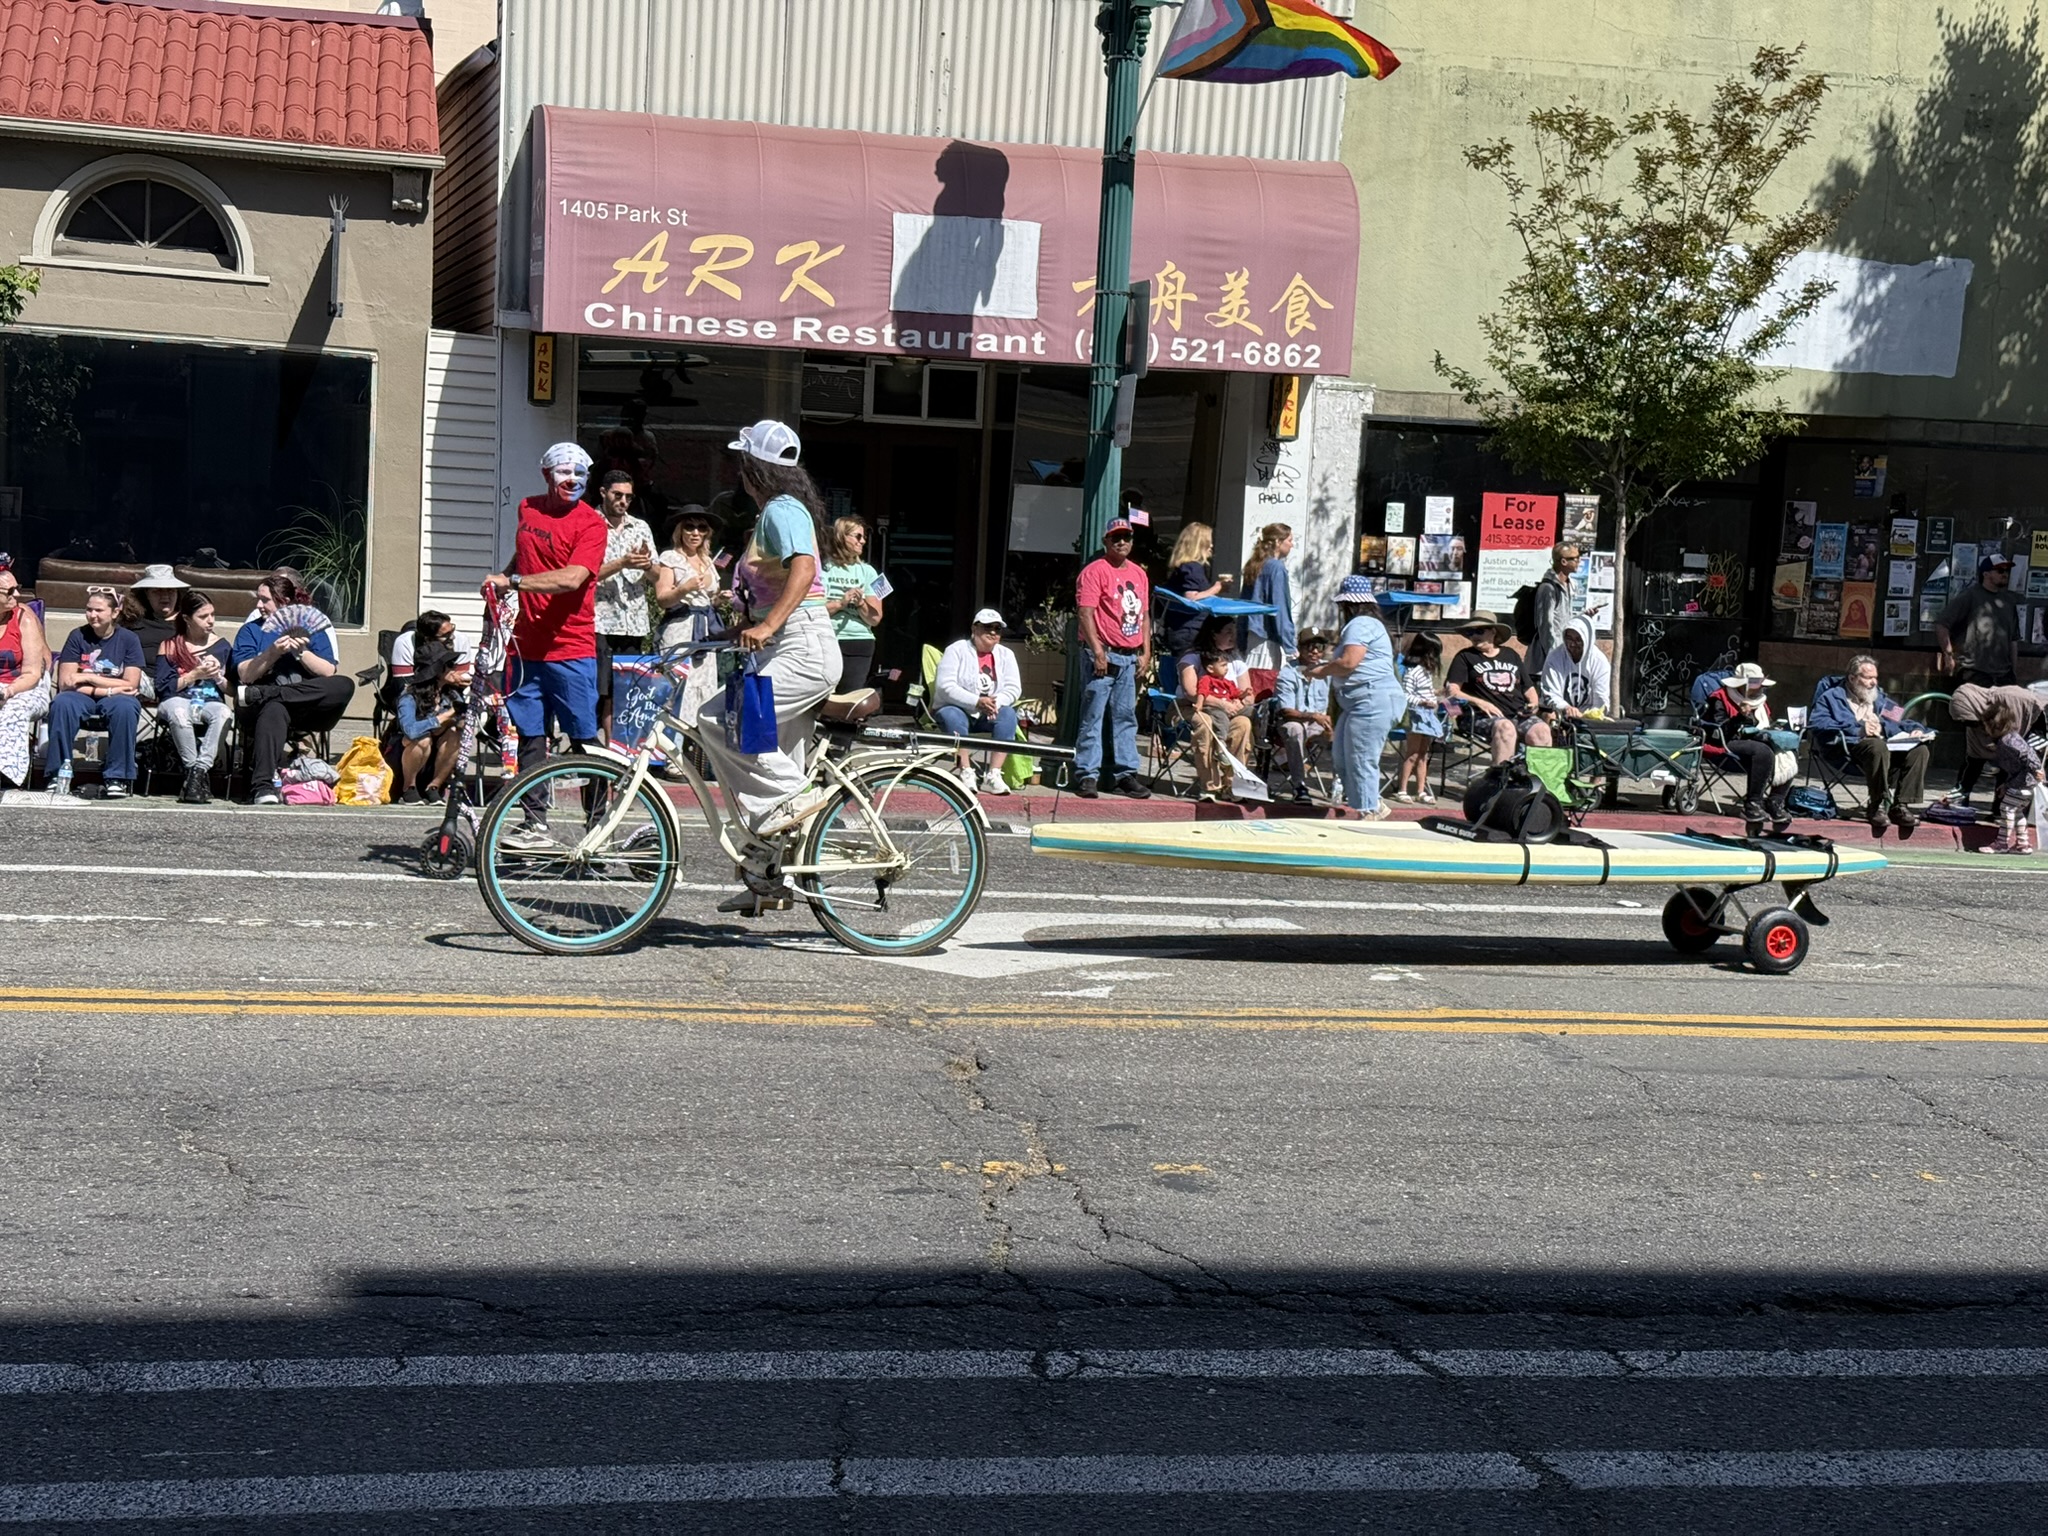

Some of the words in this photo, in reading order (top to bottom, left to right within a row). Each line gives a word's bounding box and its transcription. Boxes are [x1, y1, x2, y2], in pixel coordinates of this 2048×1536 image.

[559, 198, 608, 219] 1405
[614, 204, 661, 224] Park
[667, 208, 688, 226] St
[601, 230, 845, 307] ARK
[584, 302, 777, 339] Chinese
[792, 317, 1046, 355] Restaurant
[1170, 337, 1322, 368] 521-6862
[536, 342, 549, 393] ARK
[1258, 492, 1294, 504] PABLO
[1505, 497, 1537, 513] For
[1492, 514, 1545, 531] Lease
[1482, 558, 1507, 566] Justin
[1509, 558, 1529, 567] Choi
[1481, 578, 1496, 586] Jeff
[1473, 661, 1493, 674] OLD
[1494, 659, 1518, 674] NAVY
